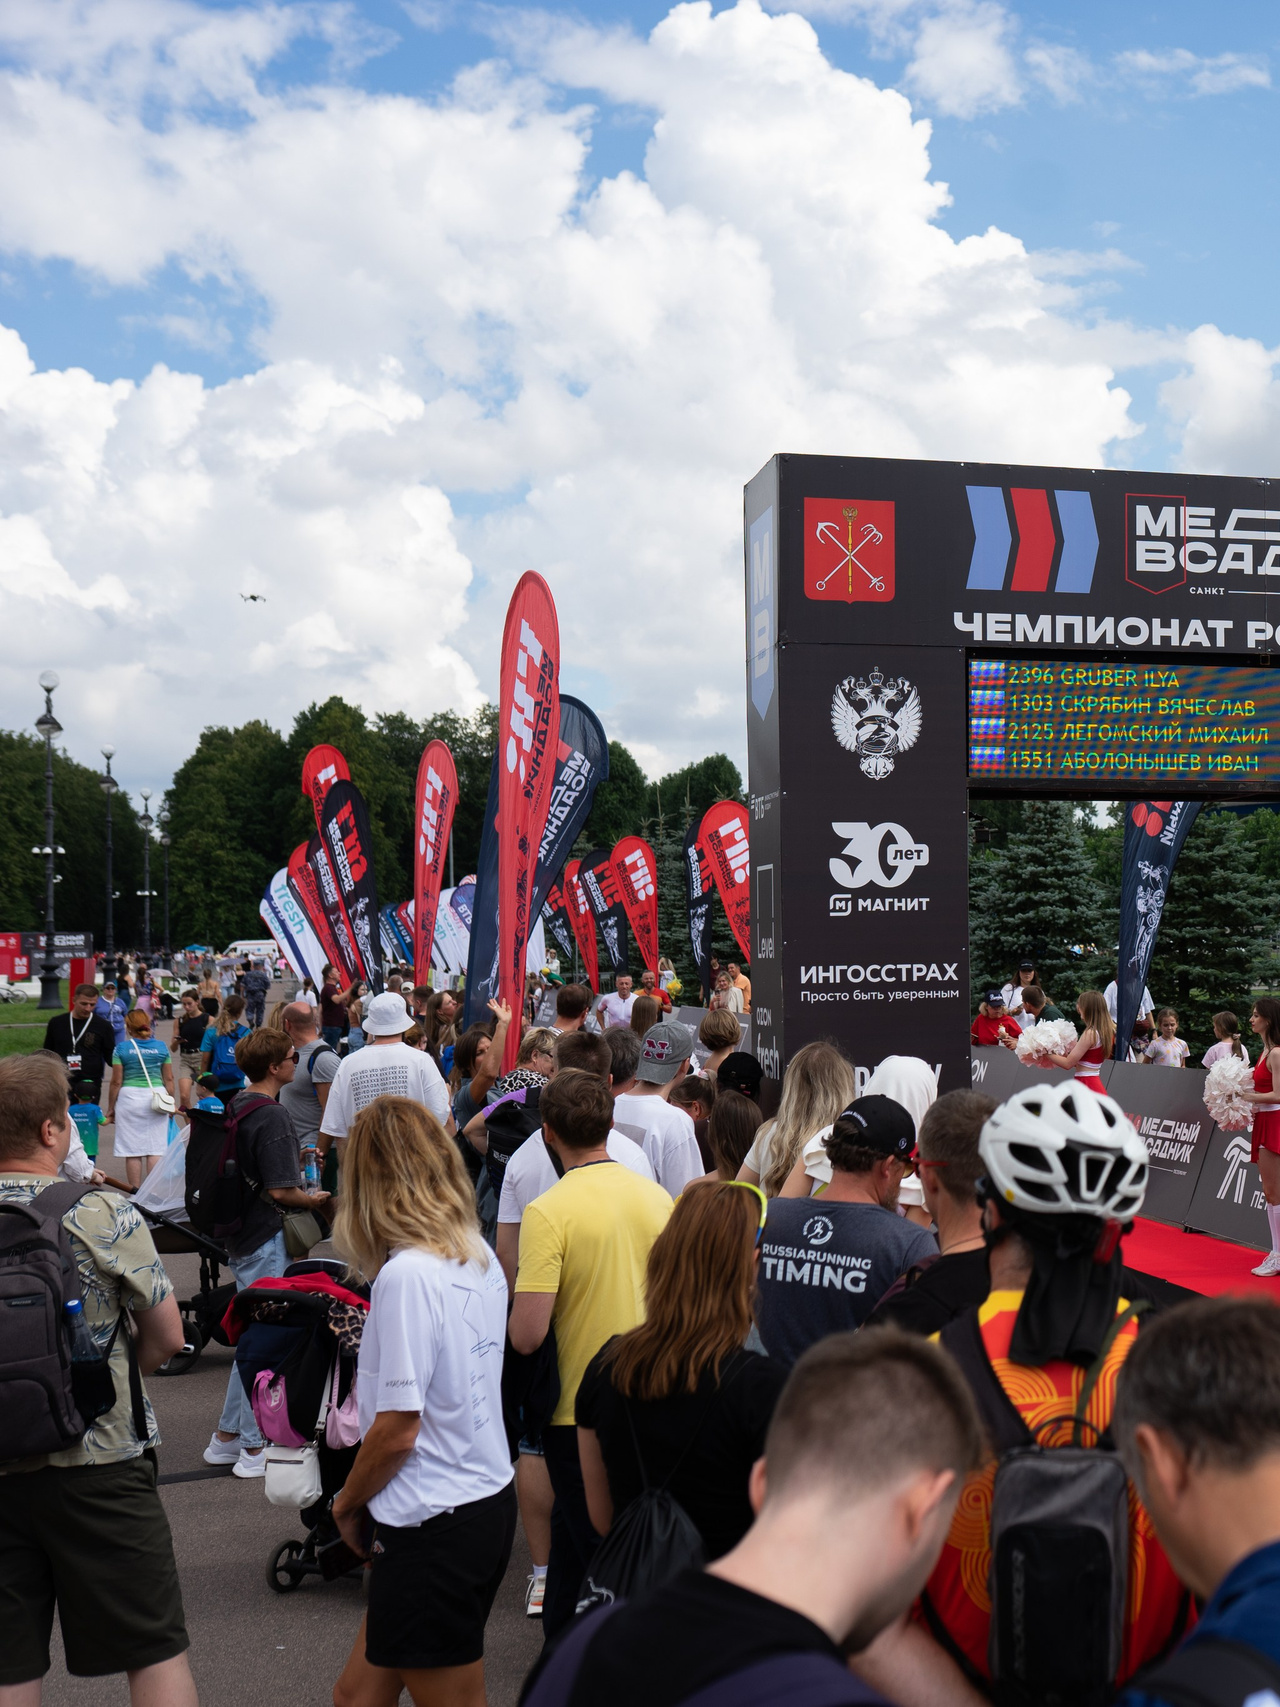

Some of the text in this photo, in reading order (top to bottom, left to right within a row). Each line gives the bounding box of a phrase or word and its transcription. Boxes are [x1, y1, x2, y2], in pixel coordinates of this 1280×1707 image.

[1189, 586, 1225, 595] САНКТ
[953, 611, 1233, 648] ЧЕМПИОНАТ
[1008, 667, 1054, 686] 2396
[1060, 667, 1138, 688] GRUBER
[1144, 670, 1180, 688] ILYA
[1009, 694, 1053, 713] 1303
[1060, 695, 1152, 715] СКРЯБИН
[1158, 697, 1256, 718] ВЯЧЕСЛАВ
[1008, 722, 1054, 741] 2125
[1060, 720, 1181, 743] ЛЕГОМСКИЙ
[1188, 725, 1269, 746] МИХАИЛ
[1009, 751, 1053, 769] 1551
[1060, 751, 1202, 772] АБОЛОНЫШЕВ
[1207, 754, 1259, 773] ИВАН
[891, 847, 924, 862] лет
[857, 896, 930, 912] МАГНИТ
[799, 962, 959, 985] ИНГОССТРАХ
[800, 988, 960, 1003] Просто быть уверенным
[1140, 1116, 1202, 1144] МЕДНЫЙ
[762, 1243, 872, 1270] RUSSIARUNNING
[762, 1257, 868, 1294] TIMING
